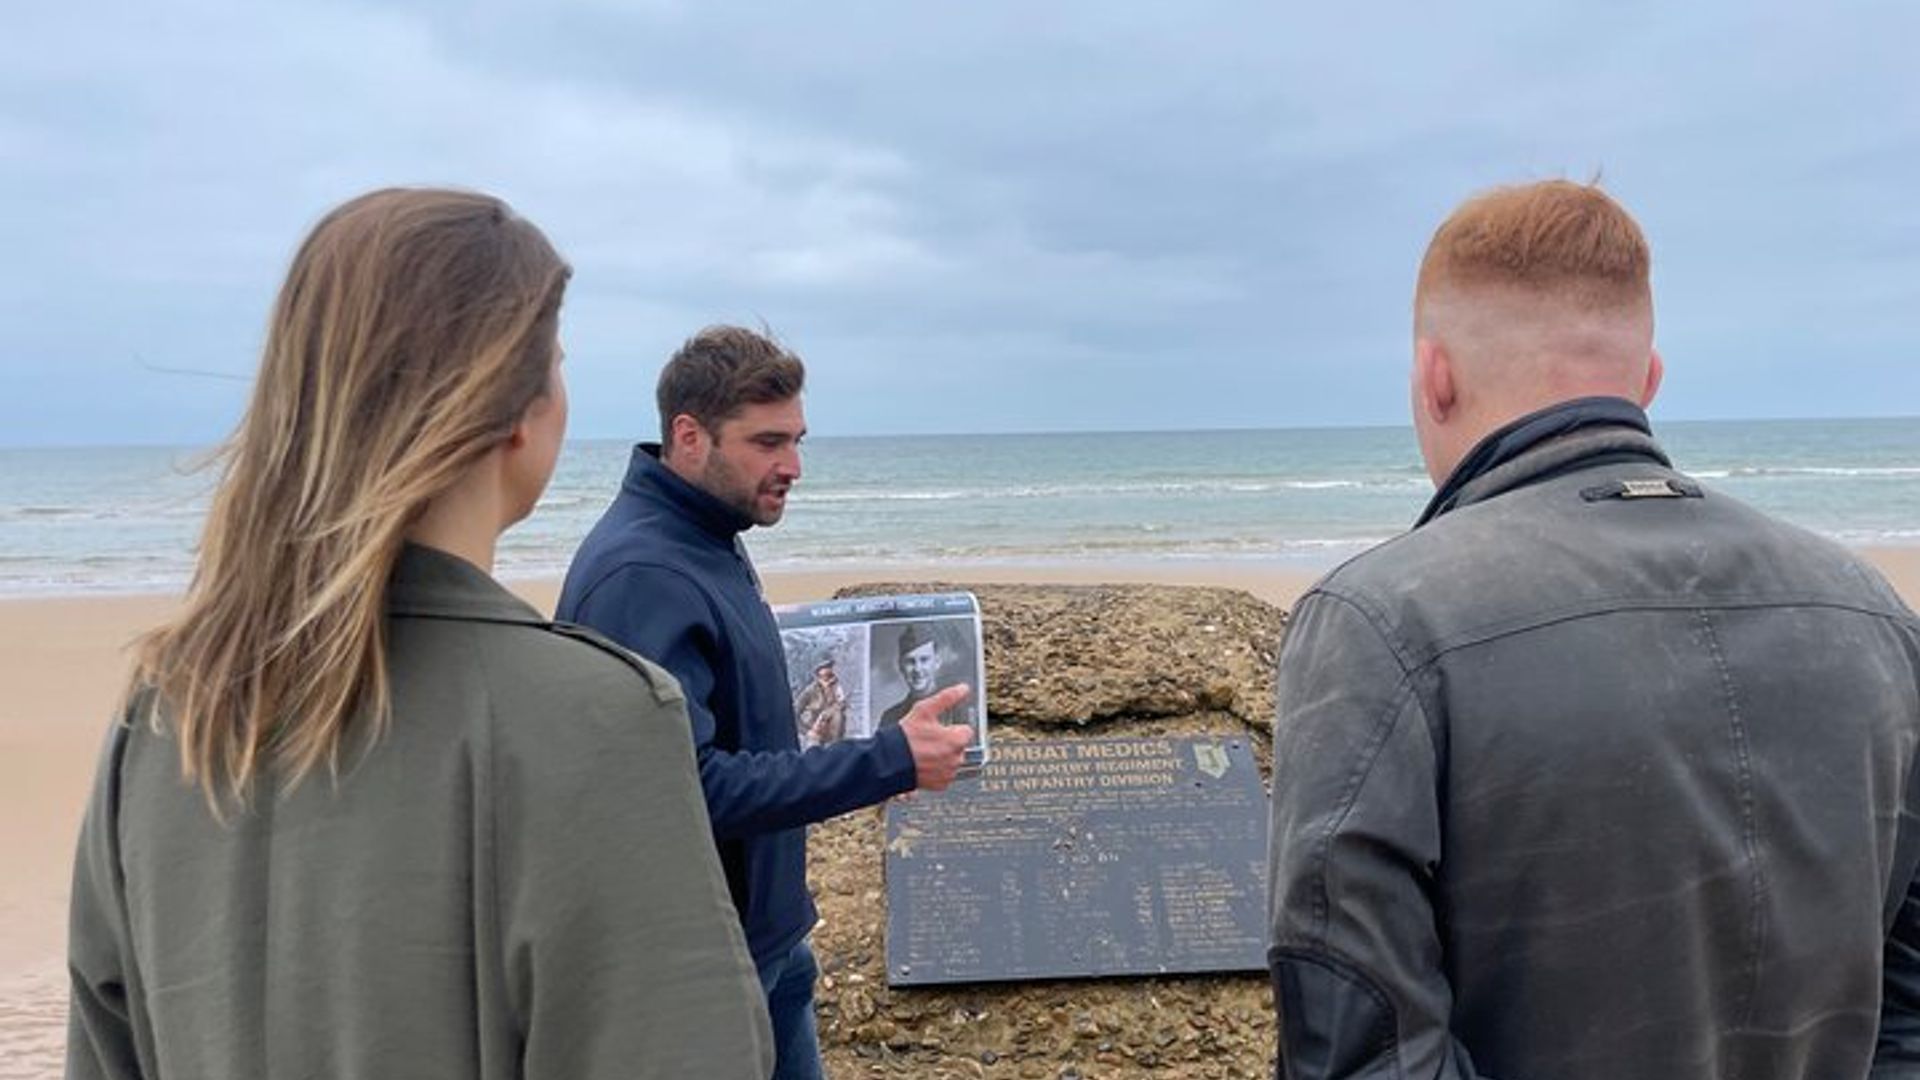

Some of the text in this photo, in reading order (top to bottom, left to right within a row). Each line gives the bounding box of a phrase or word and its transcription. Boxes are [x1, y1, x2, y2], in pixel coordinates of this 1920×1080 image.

[988, 742, 1172, 760] OMBAT MEDICS
[1010, 761, 1094, 775] INFANTRY
[1096, 758, 1183, 772] REGIMENT
[980, 773, 1174, 792] 1ST INFANTRY DIVISION
